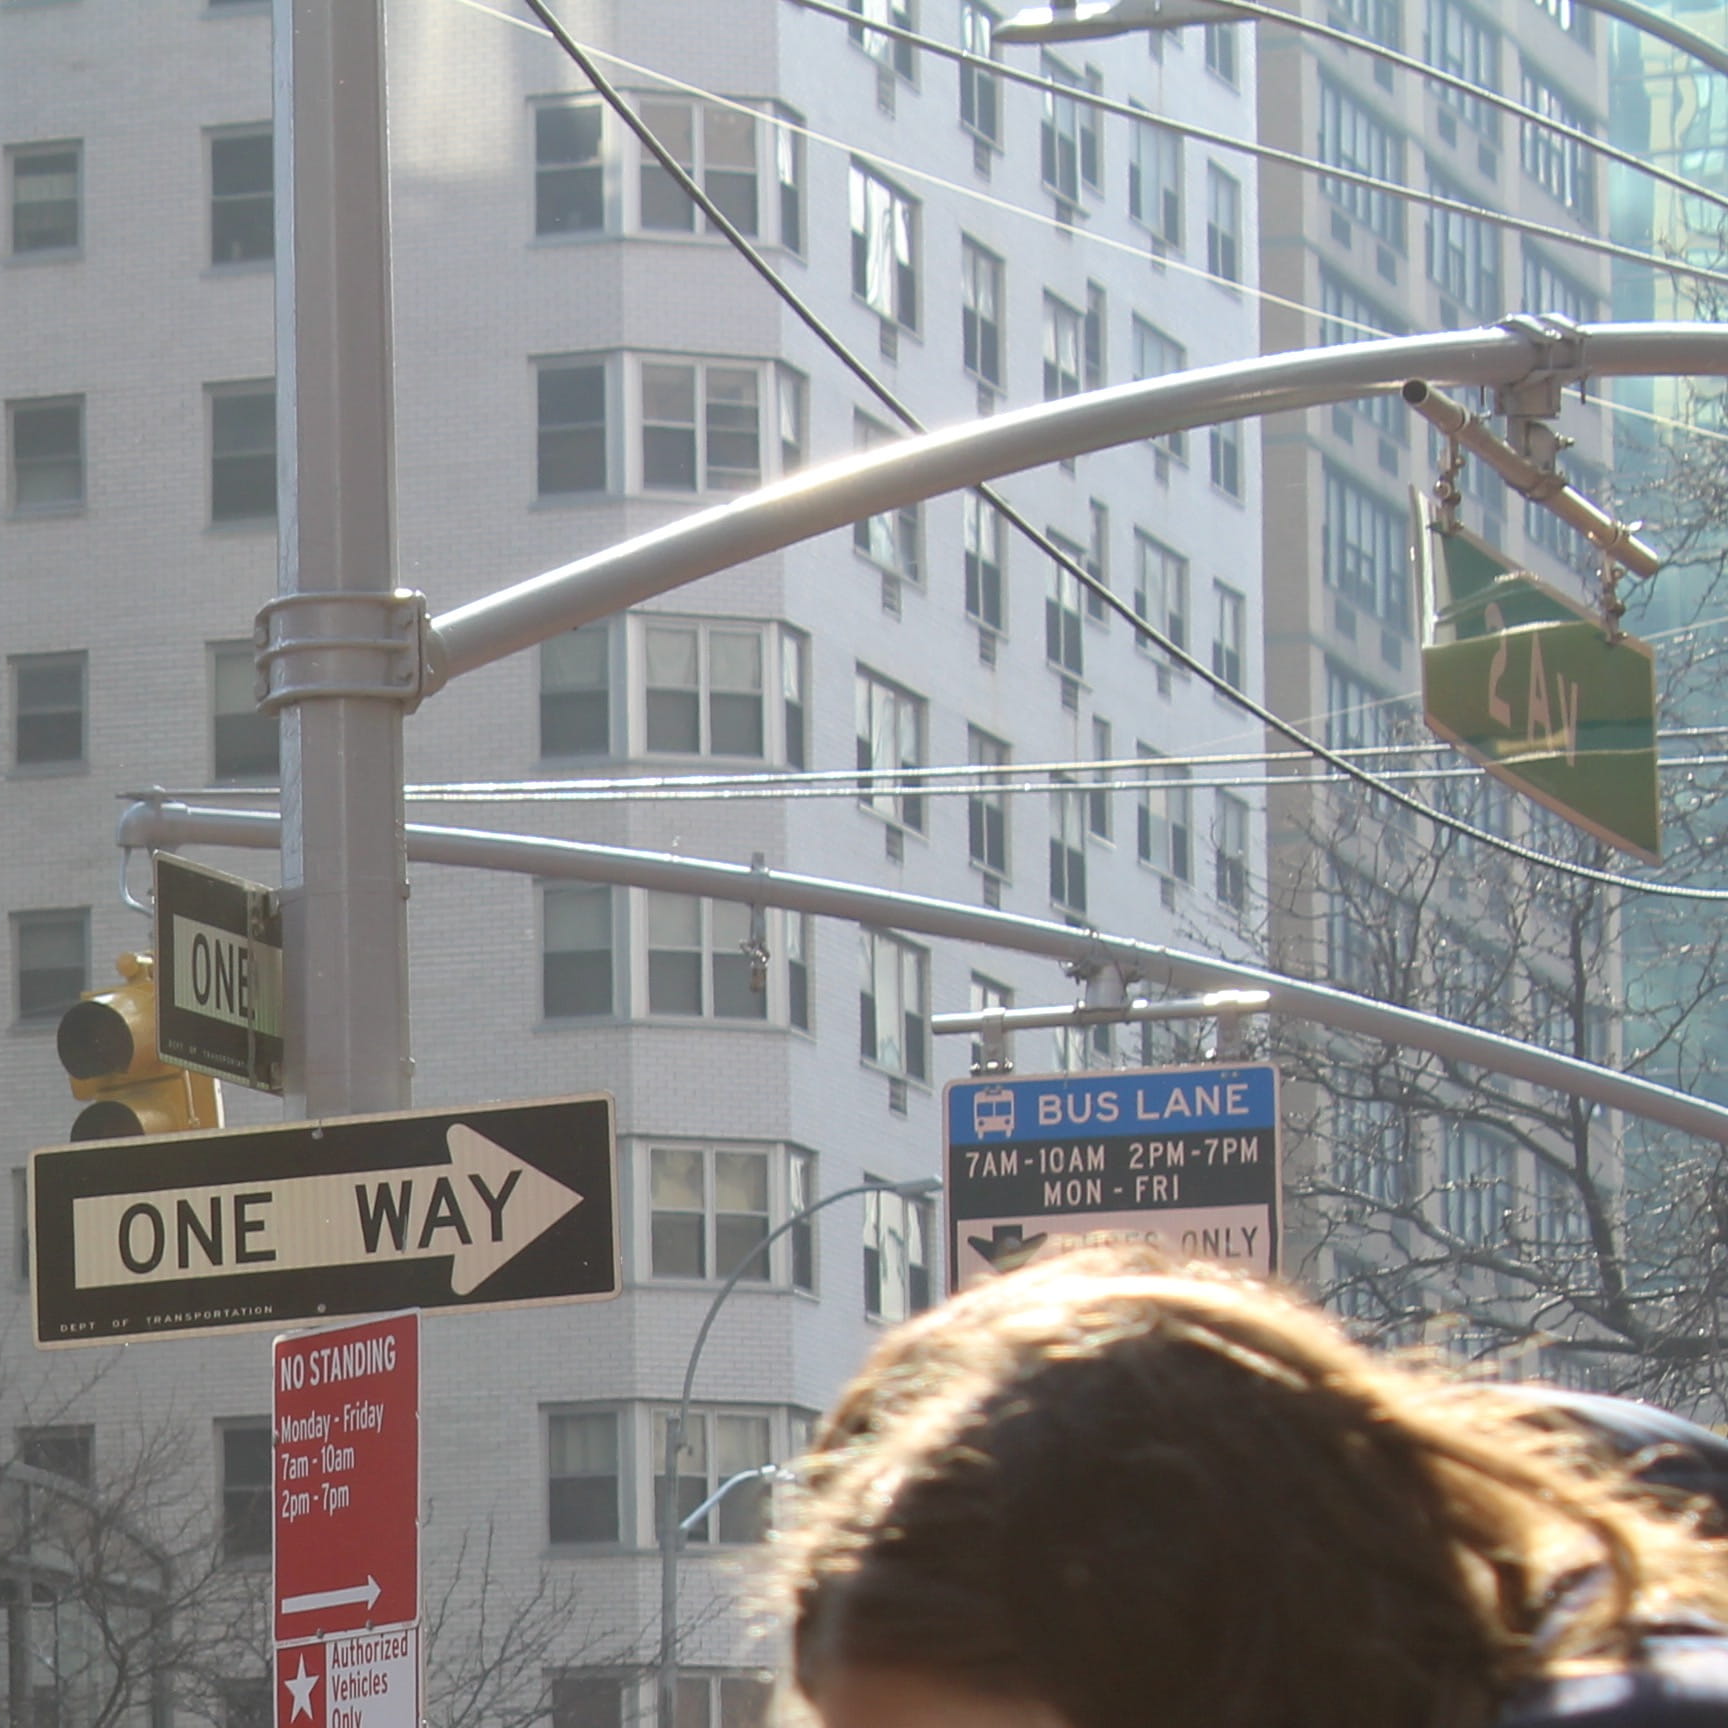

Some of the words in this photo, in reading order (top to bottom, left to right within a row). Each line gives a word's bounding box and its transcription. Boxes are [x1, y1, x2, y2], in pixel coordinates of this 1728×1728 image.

[192, 931, 255, 1020] ONE
[1038, 1091, 1120, 1126] BUS
[1137, 1084, 1249, 1121] LANE
[1044, 1179, 1102, 1207] MON
[1135, 1174, 1180, 1204] FRI
[118, 1191, 277, 1275] ONE
[355, 1169, 523, 1254] WAY
[1182, 1226, 1258, 1258] ONLY
[60, 1319, 97, 1334] DEPT
[112, 1317, 129, 1328] OF
[146, 1304, 274, 1326] TRANSPORTATION
[281, 1353, 304, 1391] NO
[309, 1335, 396, 1387] STANDING
[281, 1408, 330, 1444] Monday
[343, 1400, 384, 1433] Friday
[281, 1453, 309, 1482] 7am
[321, 1444, 355, 1475] 10am
[281, 1489, 311, 1523] 2pm
[321, 1483, 350, 1516] 7pm
[332, 1630, 408, 1669] Authorized
[332, 1669, 388, 1702] Vehicles
